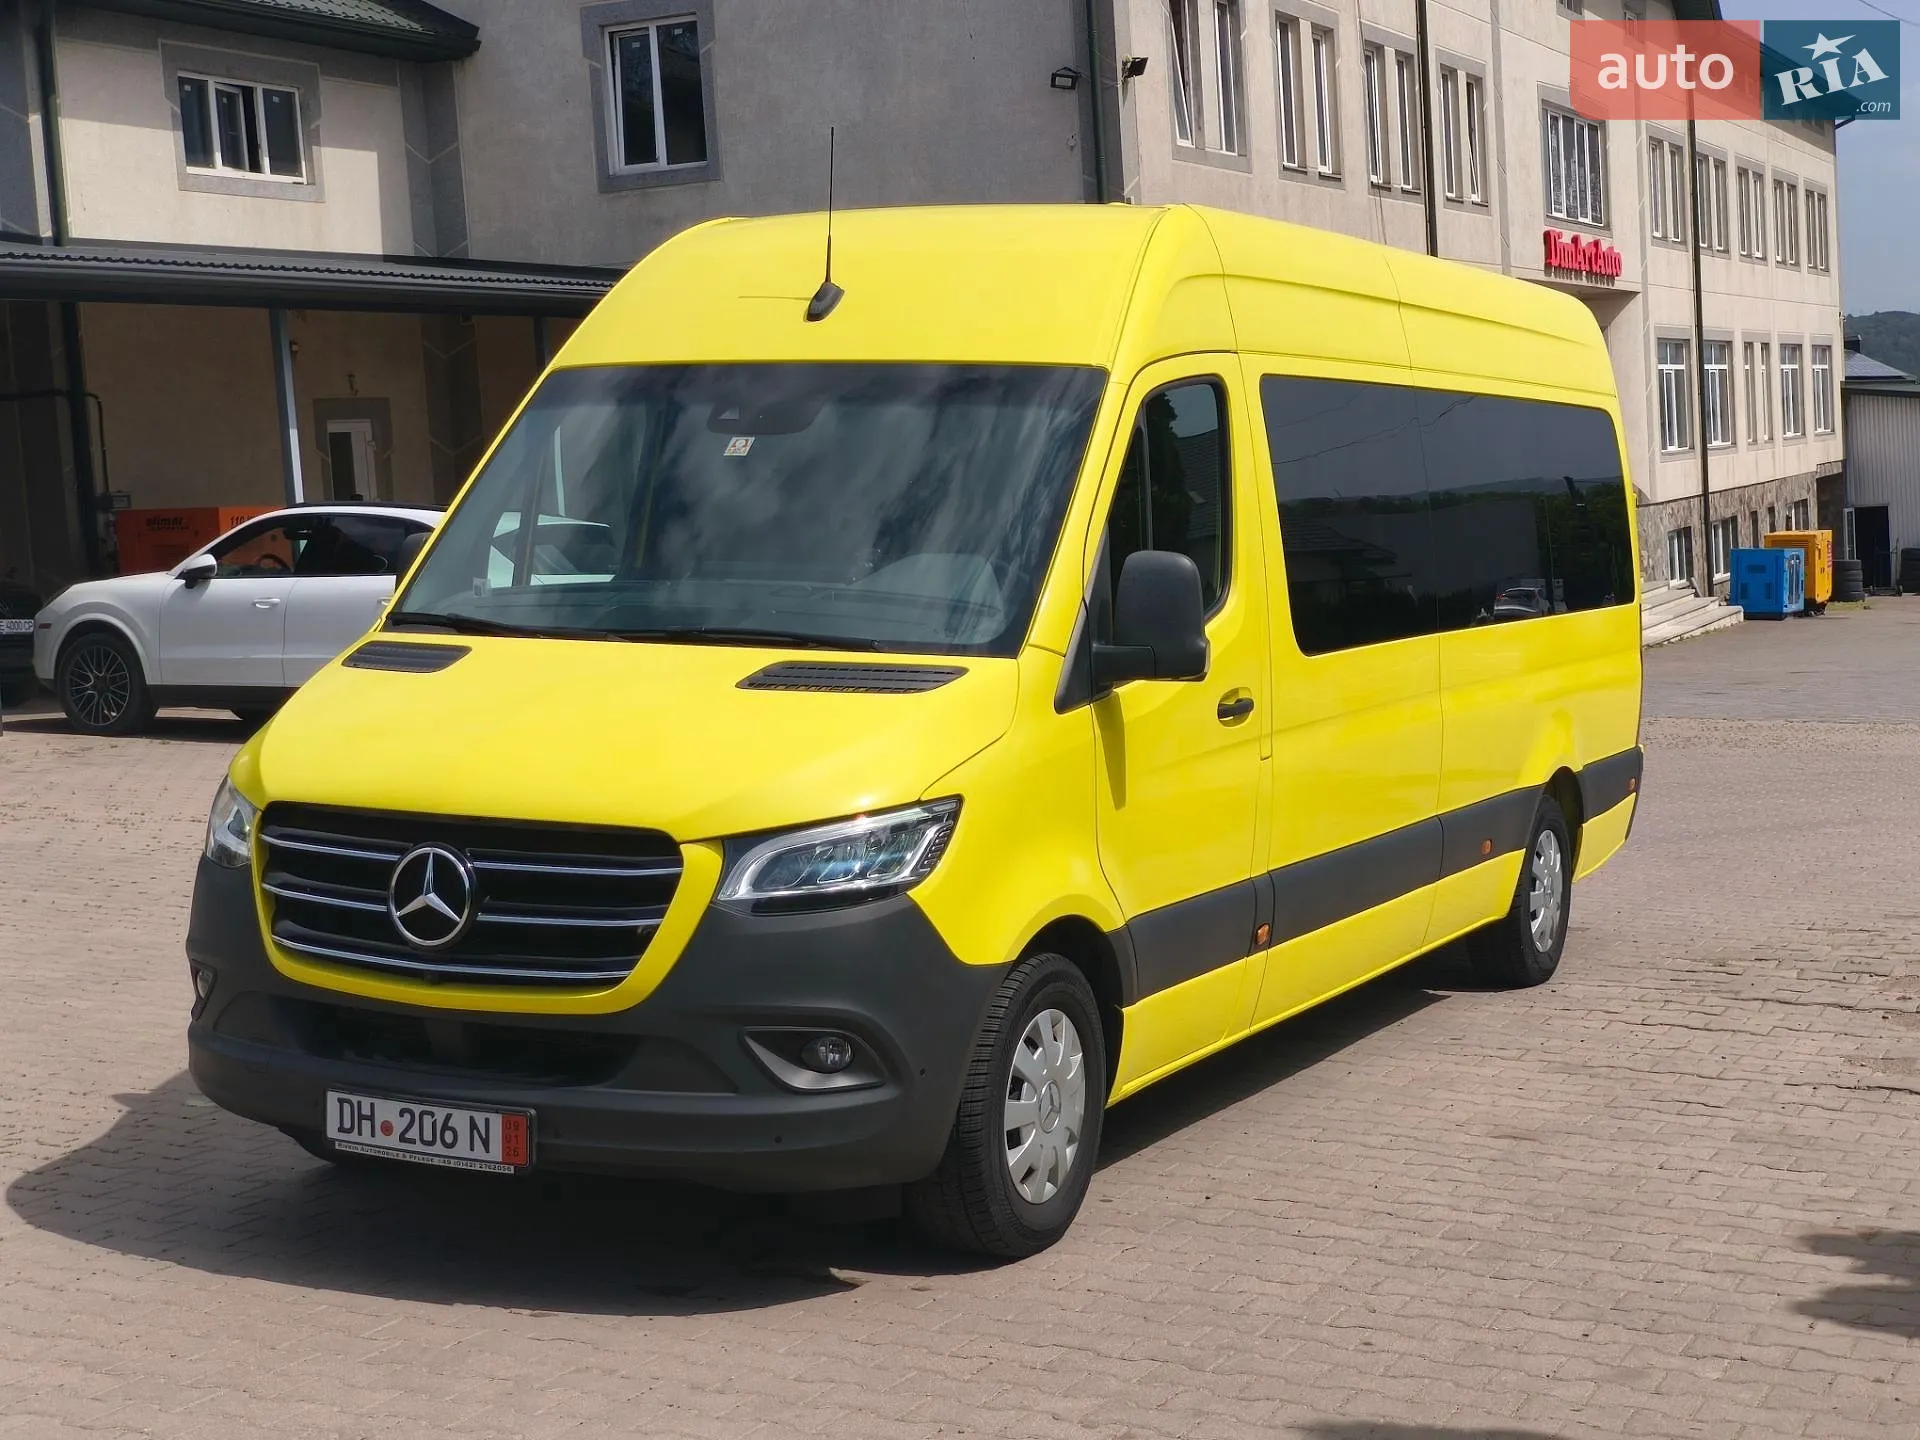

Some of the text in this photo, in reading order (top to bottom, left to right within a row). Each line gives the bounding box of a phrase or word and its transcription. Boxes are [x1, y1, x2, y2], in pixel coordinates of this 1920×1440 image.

[337, 1096, 491, 1154] DH 206 N
